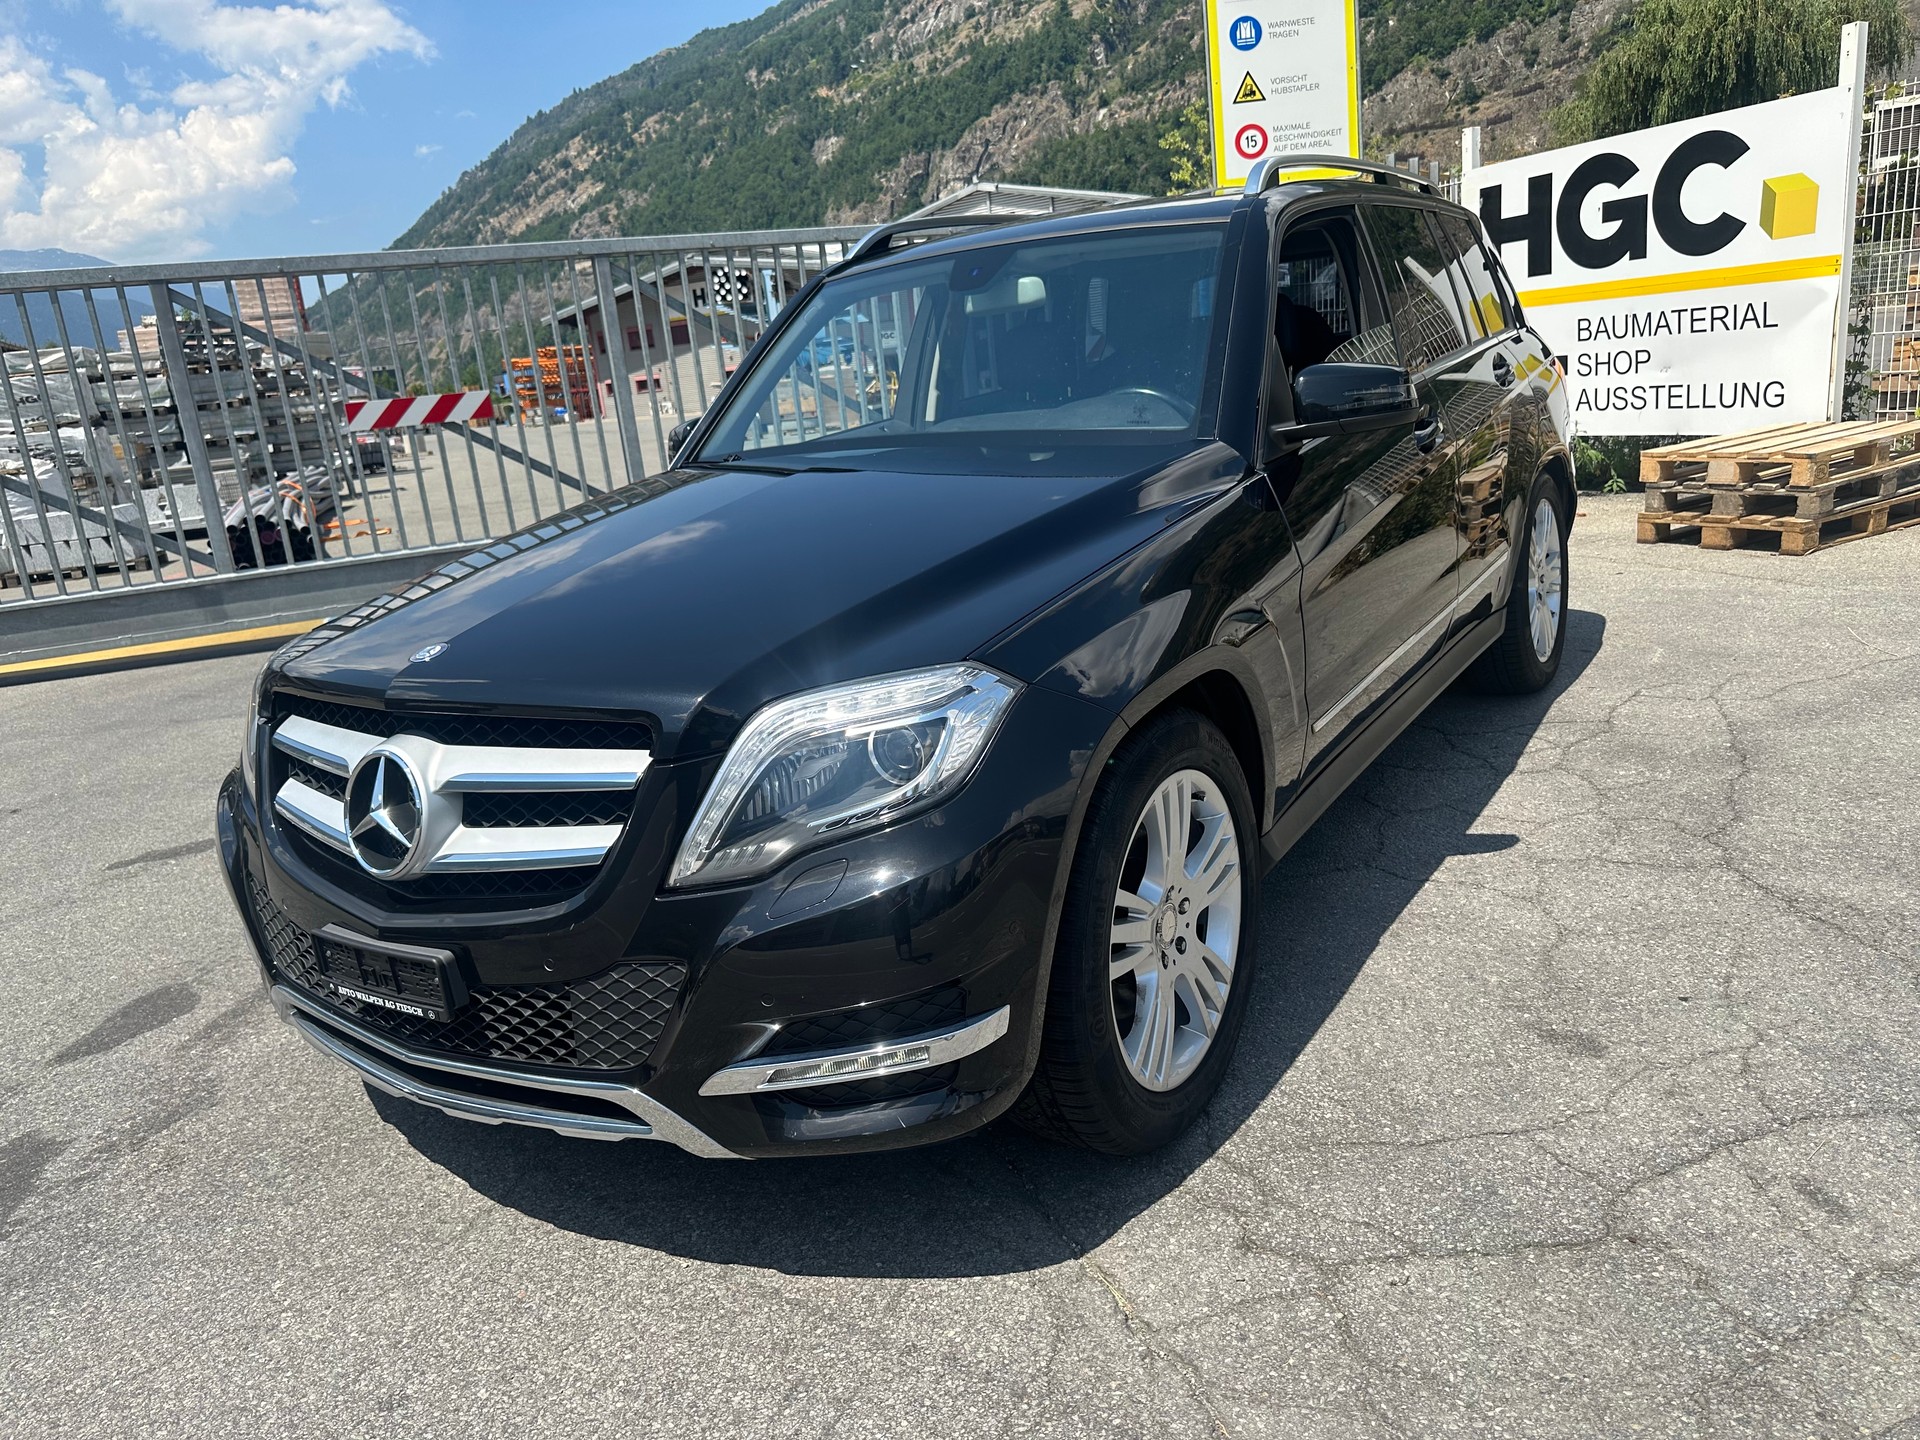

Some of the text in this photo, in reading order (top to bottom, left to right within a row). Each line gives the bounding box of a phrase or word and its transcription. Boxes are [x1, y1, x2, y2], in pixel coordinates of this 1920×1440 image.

[1267, 17, 1315, 29] WARNWESTE
[1268, 29, 1299, 39] TRAGEN
[1270, 74, 1307, 85] VORSICHT
[1271, 82, 1320, 95] HUBSTAPLER
[1272, 122, 1311, 133] MAXIMALE
[1245, 134, 1258, 149] 15
[1273, 128, 1342, 143] GESCHWINDIGKEIT
[1273, 139, 1332, 152] AUF DEM AREAL
[1479, 129, 1750, 278] HGC
[1576, 301, 1779, 343] BAUMATERIAL
[1576, 349, 1652, 377] SHOP
[1575, 380, 1786, 412] AUSSTELLUNG
[338, 986, 424, 1017] AUTO WALPEN AG FIESCH
